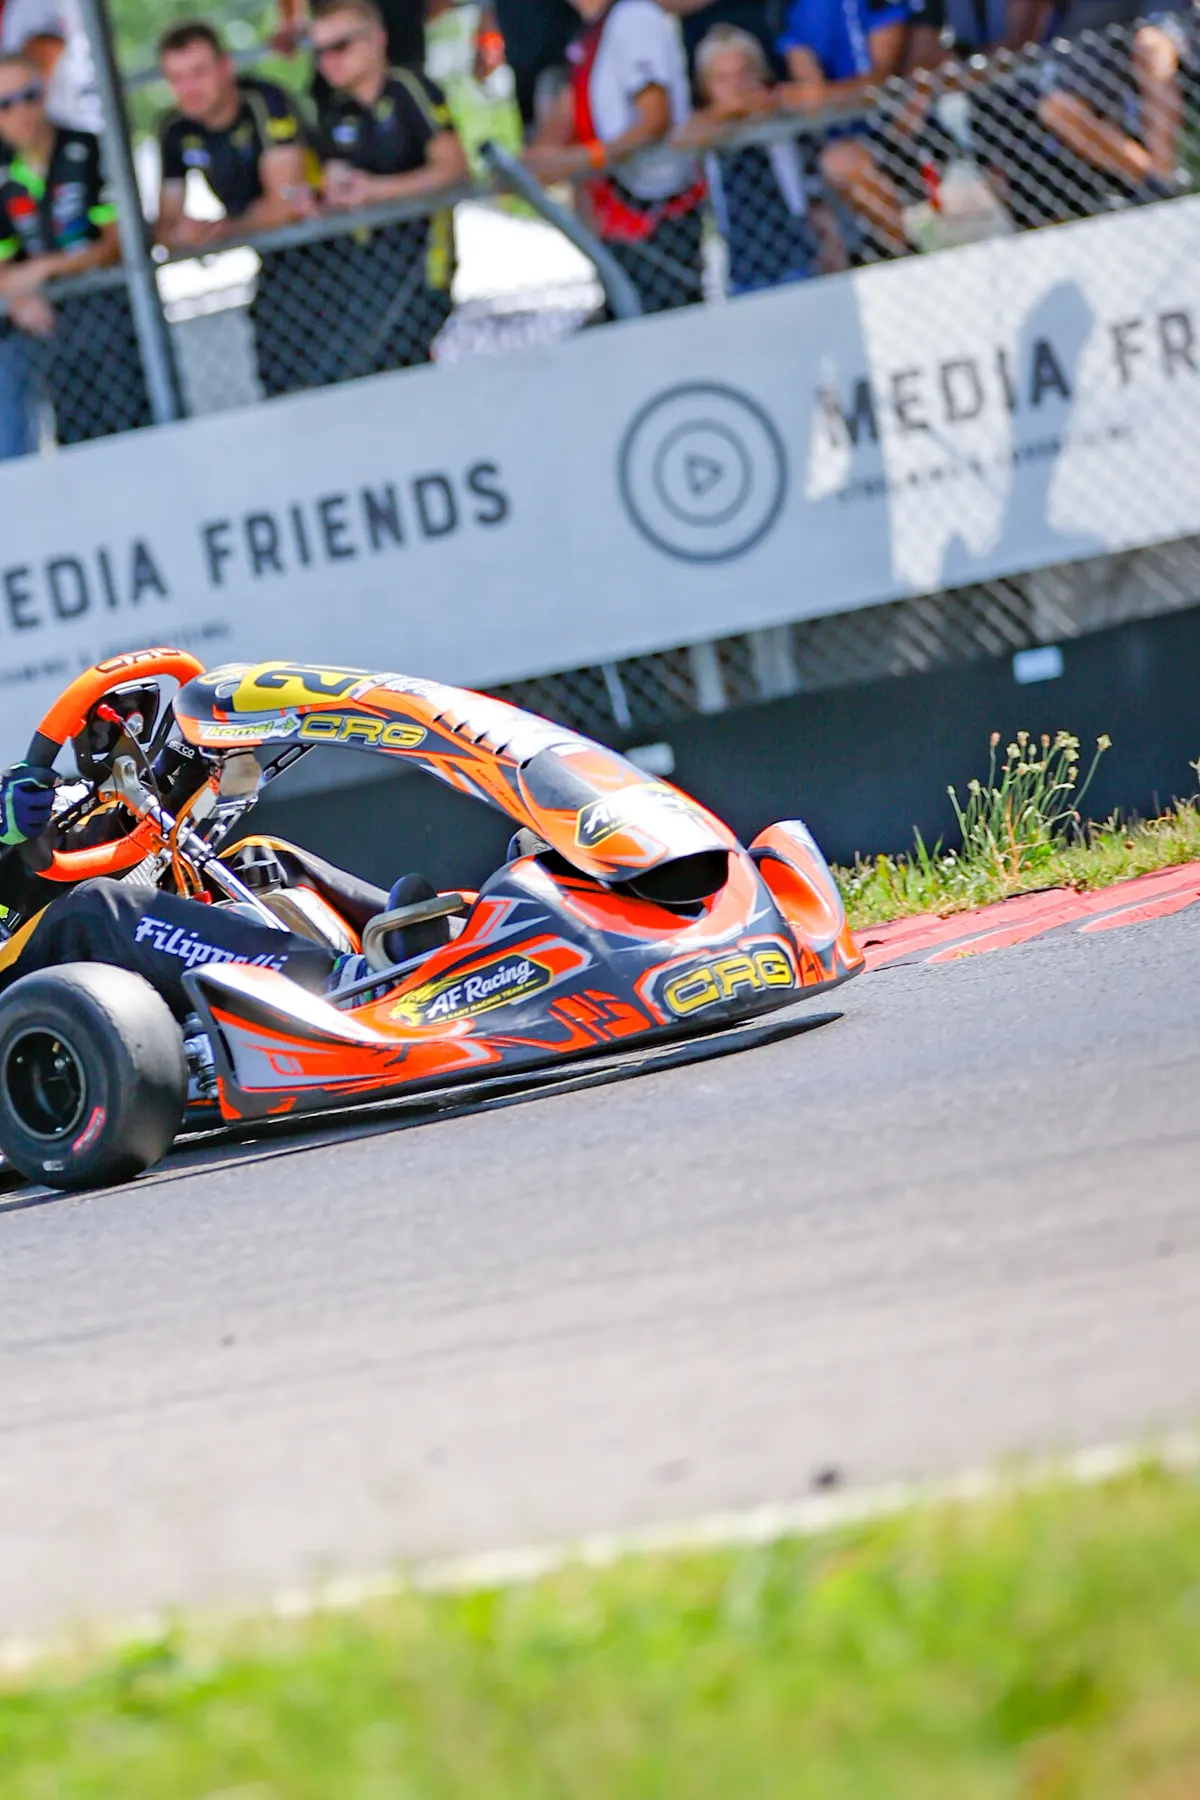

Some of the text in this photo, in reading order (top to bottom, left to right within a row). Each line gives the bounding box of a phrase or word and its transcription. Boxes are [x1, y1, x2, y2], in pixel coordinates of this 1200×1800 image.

[816, 334, 1072, 449] MEDIA
[200, 460, 512, 584] FRIENDS
[300, 713, 426, 747] CRG
[425, 961, 536, 1018] AF Racing
[664, 950, 794, 1017] CRG
